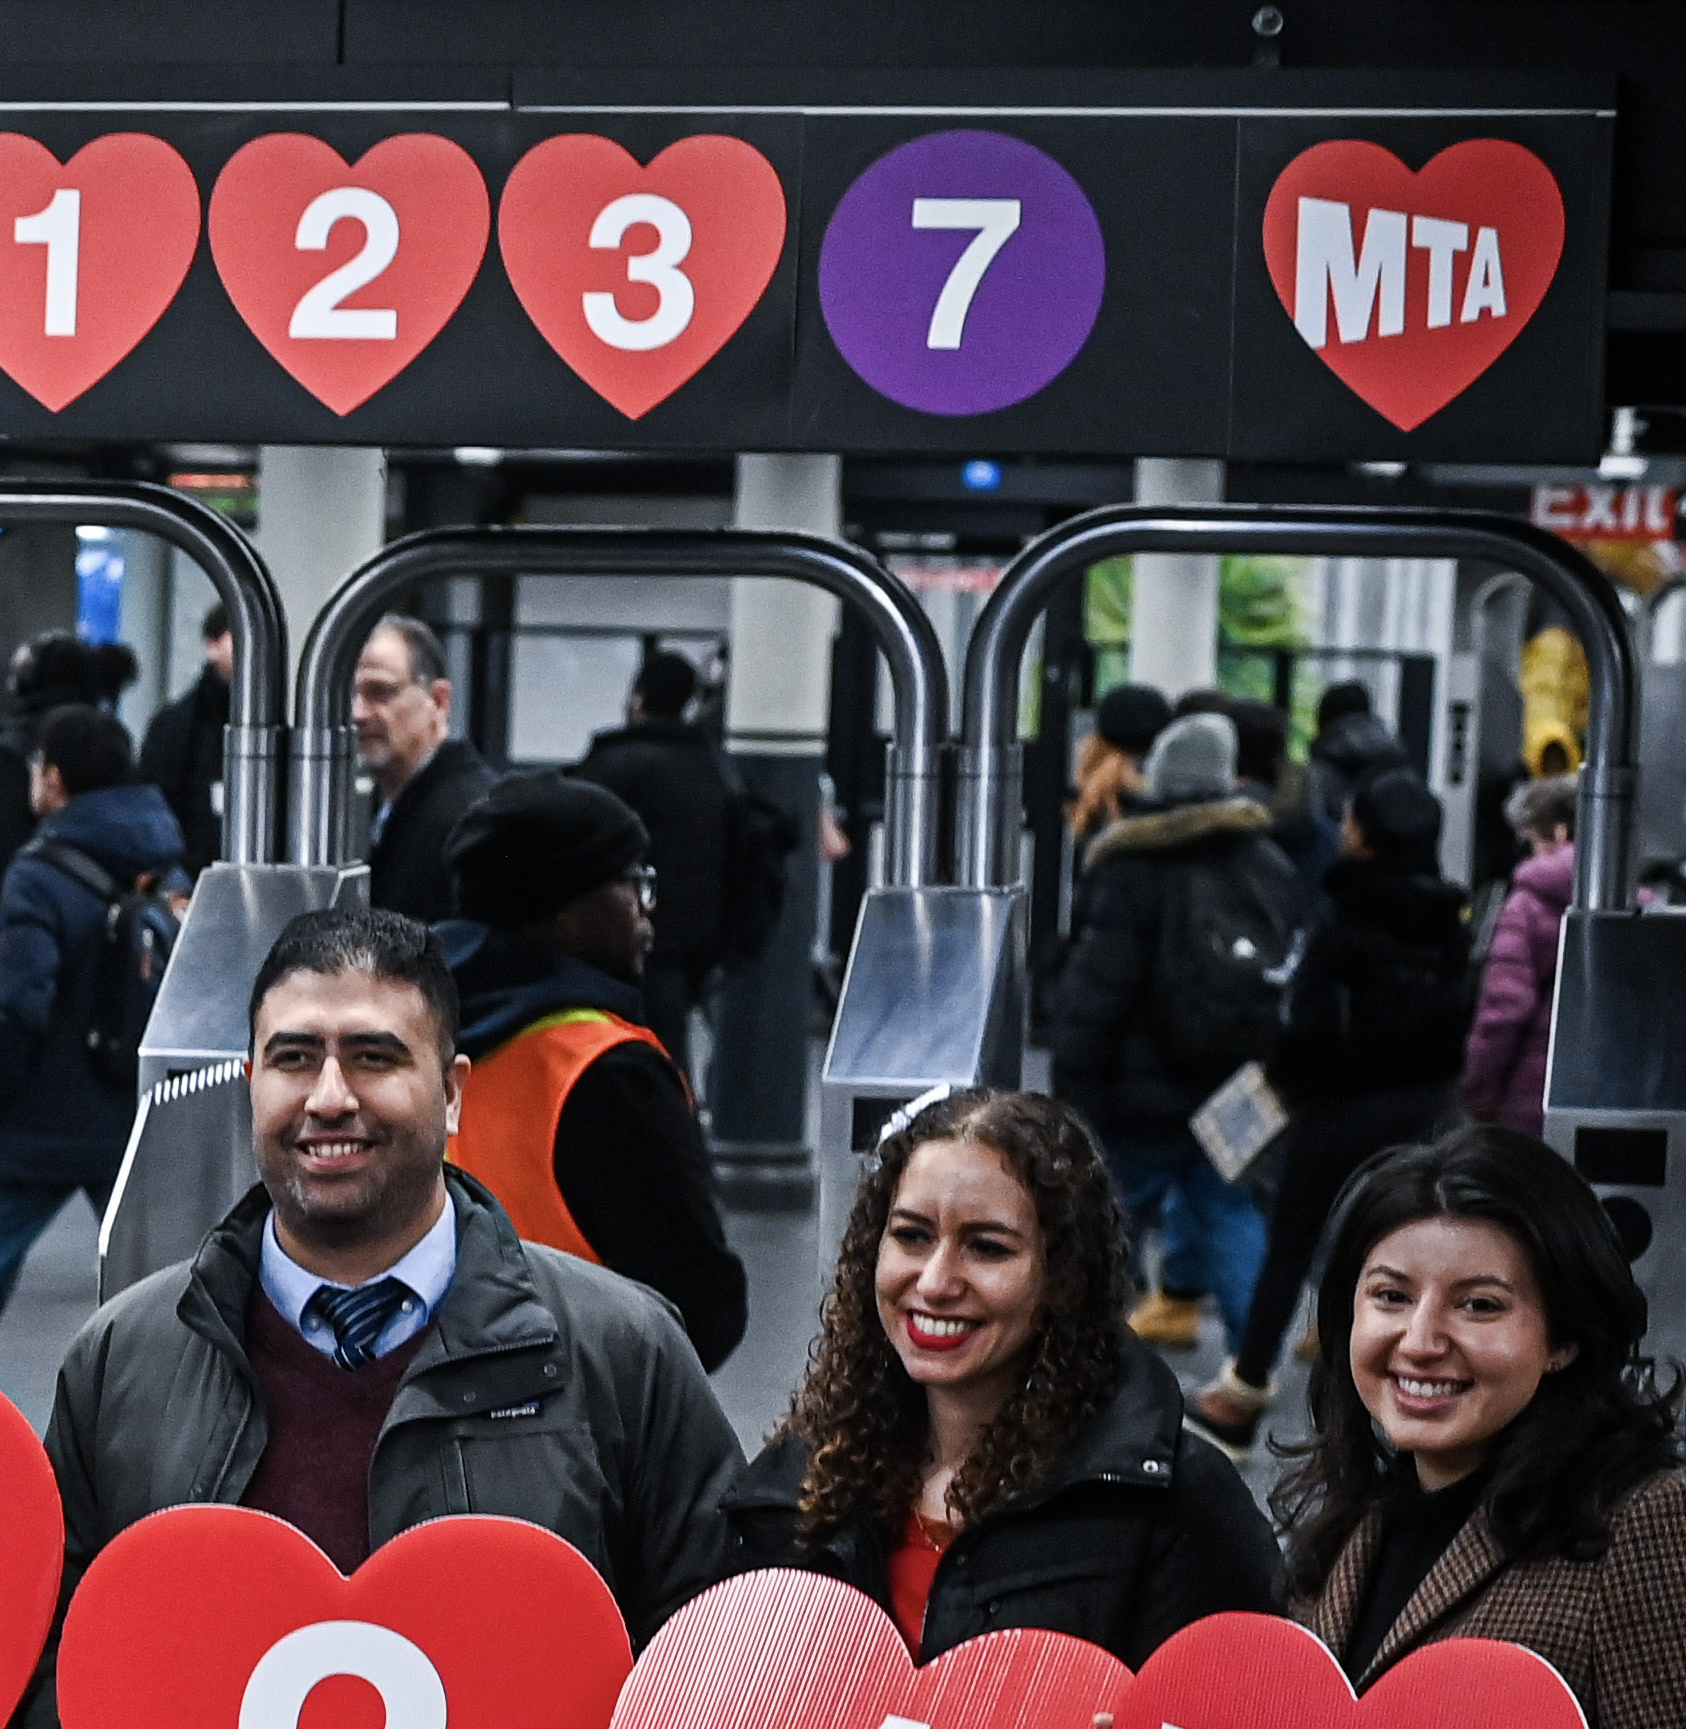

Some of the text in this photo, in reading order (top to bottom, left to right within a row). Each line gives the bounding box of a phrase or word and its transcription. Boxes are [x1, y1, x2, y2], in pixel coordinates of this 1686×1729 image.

[13, 188, 81, 337] 1
[288, 187, 400, 340] 2
[582, 193, 695, 351] 3
[912, 198, 1021, 349] 7
[1294, 197, 1507, 349] MTA
